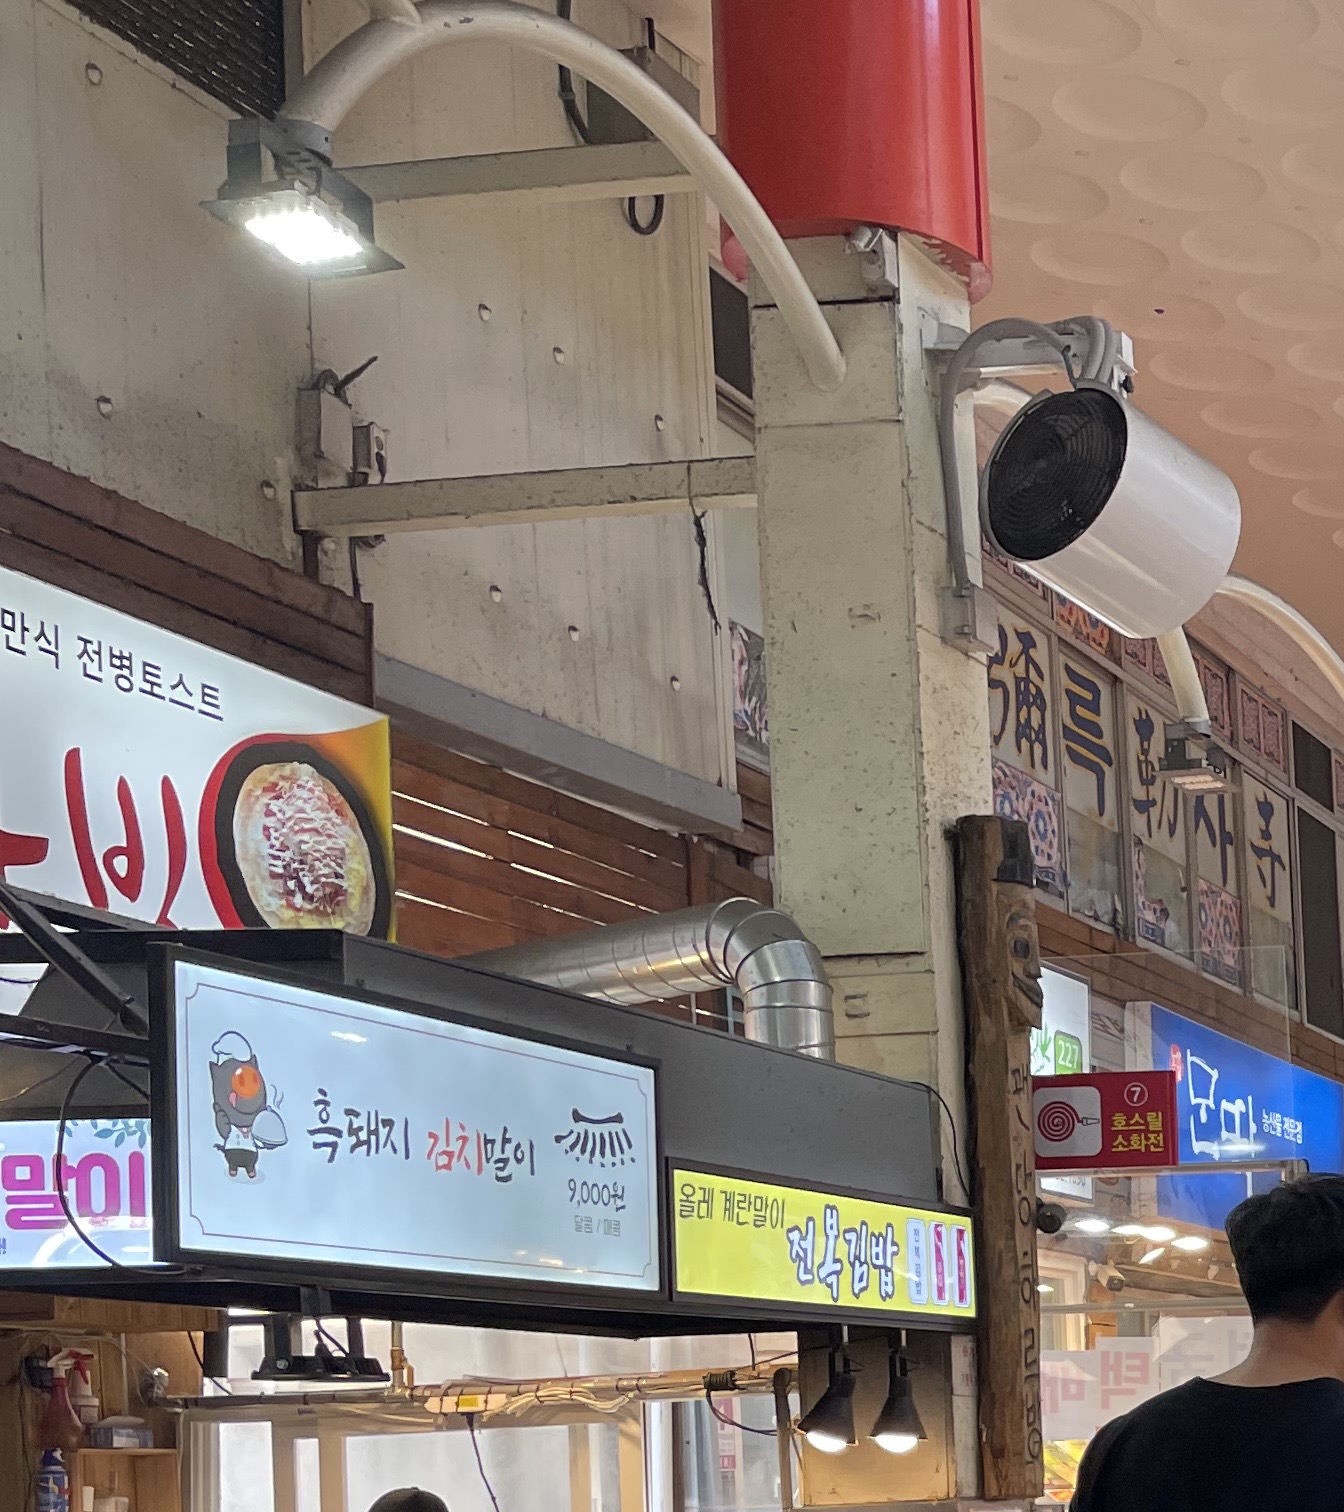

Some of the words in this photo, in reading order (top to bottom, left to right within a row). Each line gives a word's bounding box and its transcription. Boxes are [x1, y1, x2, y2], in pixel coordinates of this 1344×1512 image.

[76, 634, 225, 721] 전병토스트
[1057, 1040, 1080, 1068] 227
[308, 1089, 411, 1164] 흑돼지
[427, 1115, 536, 1184] 김치말이
[1111, 1111, 1163, 1132] 호스릴
[1111, 1133, 1165, 1153] 소화전
[568, 1178, 626, 1212] 9,000원
[679, 1183, 715, 1219] 올레
[720, 1189, 786, 1229] 계란말이
[787, 1204, 899, 1302] 전복김밥
